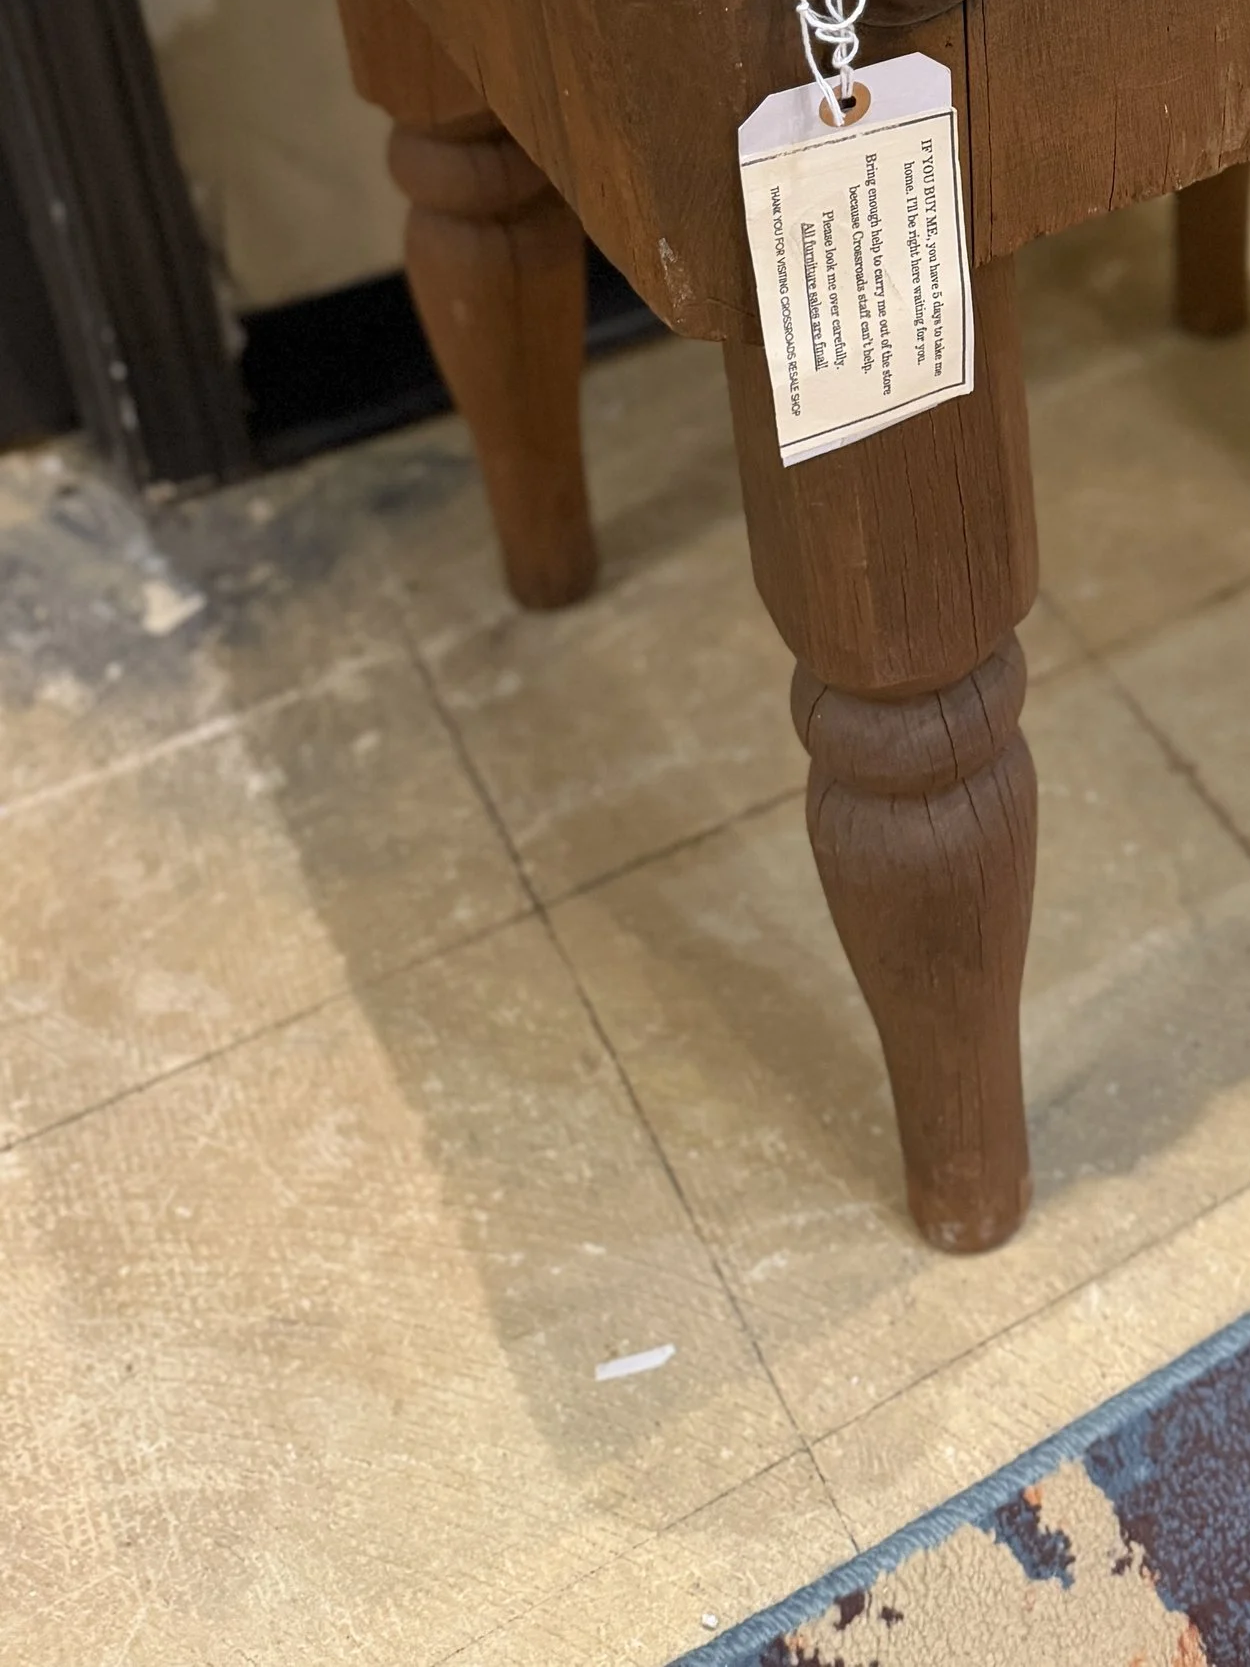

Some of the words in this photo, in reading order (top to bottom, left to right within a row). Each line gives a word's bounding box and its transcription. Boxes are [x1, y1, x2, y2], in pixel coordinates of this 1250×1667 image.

[921, 139, 932, 153] IF
[865, 153, 878, 186] Bring
[904, 161, 915, 194] home.
[922, 156, 934, 184] YOU
[770, 186, 781, 215] THANK
[849, 185, 860, 229] because
[867, 188, 881, 227] enough
[907, 197, 918, 212] I'll
[924, 186, 936, 213] BUY
[773, 216, 783, 235] YOU
[801, 223, 815, 238] All
[823, 210, 834, 247] Please
[908, 214, 918, 228] be
[926, 215, 938, 241] ME,
[775, 237, 785, 256] FOR
[870, 229, 883, 253] help
[907, 230, 920, 257] right
[926, 242, 937, 262] you
[803, 241, 817, 289] furniture
[825, 248, 837, 272] look
[852, 231, 867, 292] Crossroads
[873, 255, 884, 266] to
[911, 259, 921, 284] here
[777, 257, 788, 294] VISITING
[828, 273, 836, 290] me
[874, 269, 884, 297] carry
[930, 264, 940, 289] have
[808, 292, 822, 319] sales
[829, 293, 840, 317] over
[858, 295, 870, 319] staff
[877, 300, 886, 317] me
[914, 286, 926, 326] waiting
[932, 302, 943, 325] days
[781, 297, 796, 359] CROSSROADS
[811, 321, 822, 339] are
[861, 322, 873, 348] can't
[879, 319, 890, 337] out
[917, 327, 927, 341] for
[934, 326, 943, 337] to
[813, 342, 828, 371] final!
[832, 320, 847, 370] carefully.
[881, 340, 892, 349] of
[915, 345, 926, 365] you.
[935, 338, 945, 360] take
[862, 348, 874, 374] help.
[883, 351, 892, 368] the
[935, 362, 942, 376] me
[788, 361, 799, 392] RESALE
[883, 370, 892, 395] store
[791, 394, 800, 416] SHOP
